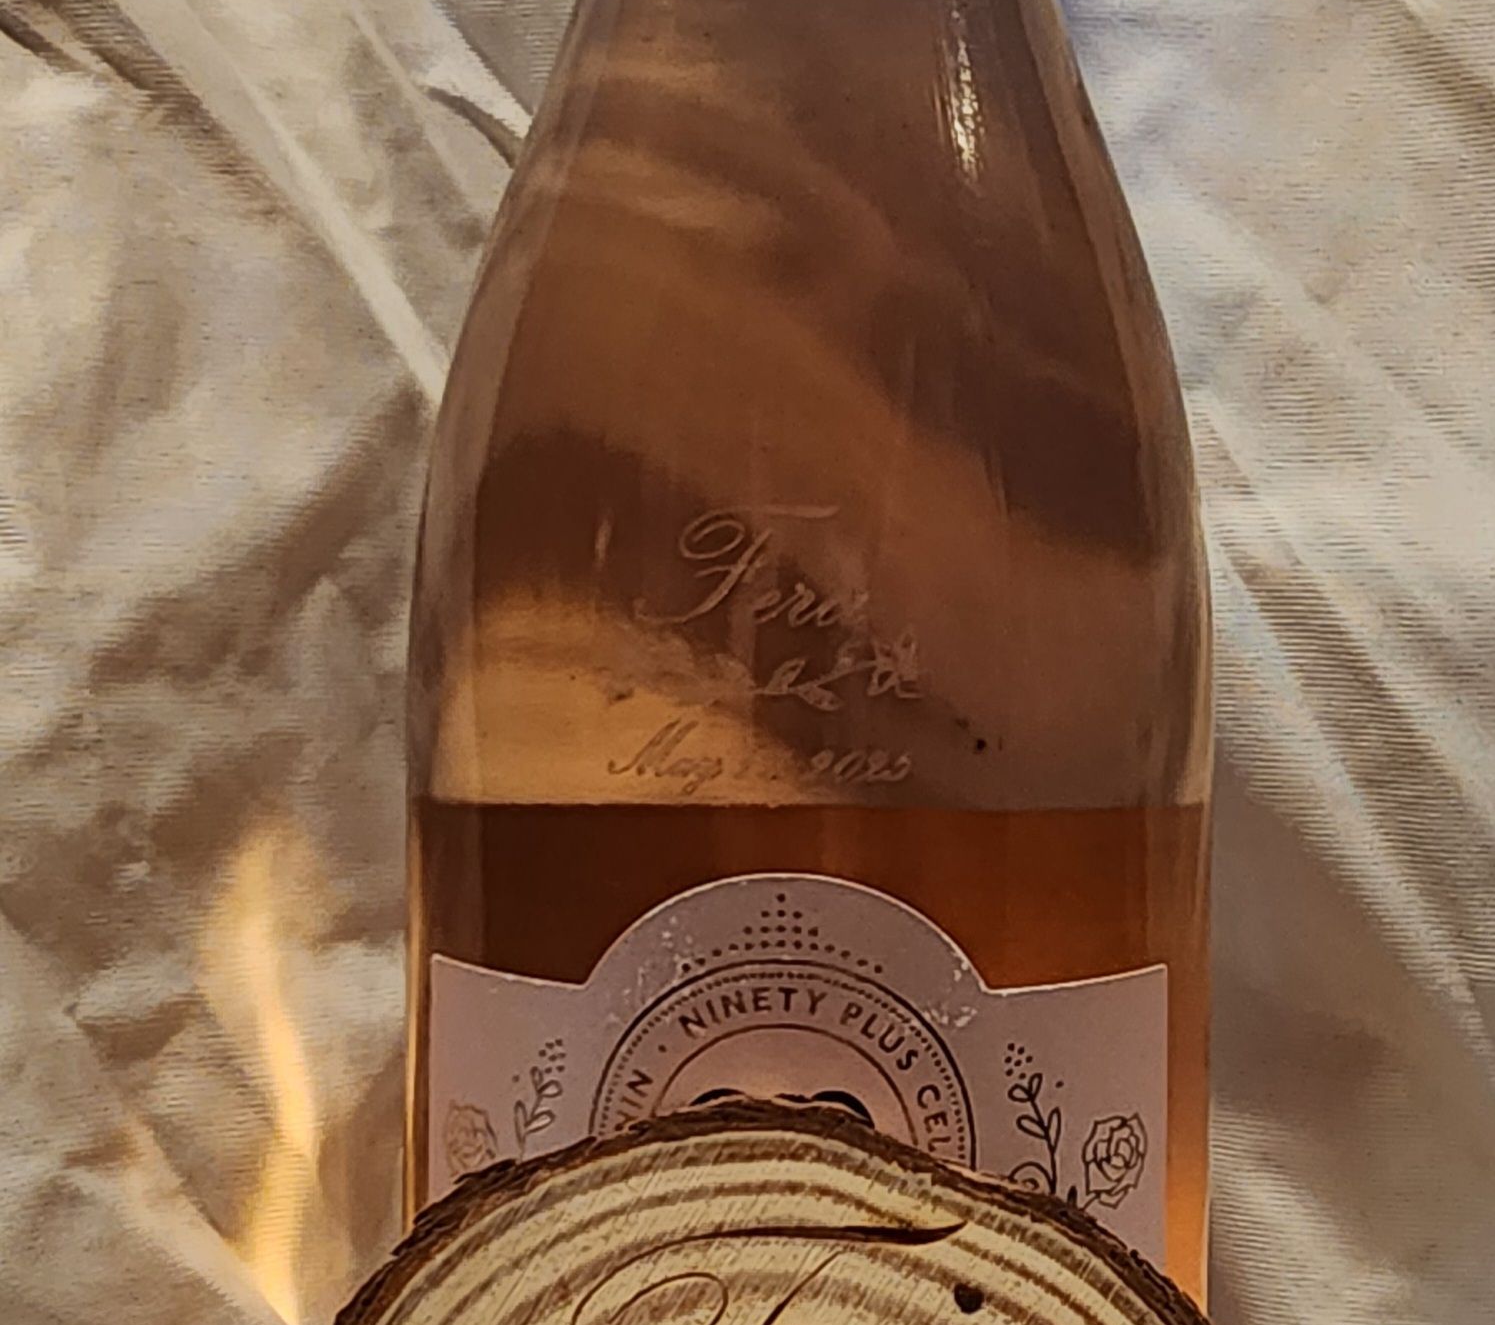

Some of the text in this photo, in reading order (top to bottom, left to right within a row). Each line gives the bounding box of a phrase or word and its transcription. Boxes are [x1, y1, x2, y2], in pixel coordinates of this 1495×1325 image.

[607, 718, 723, 795] May
[677, 986, 827, 1040] NINETY
[839, 1001, 919, 1070] PLUS
